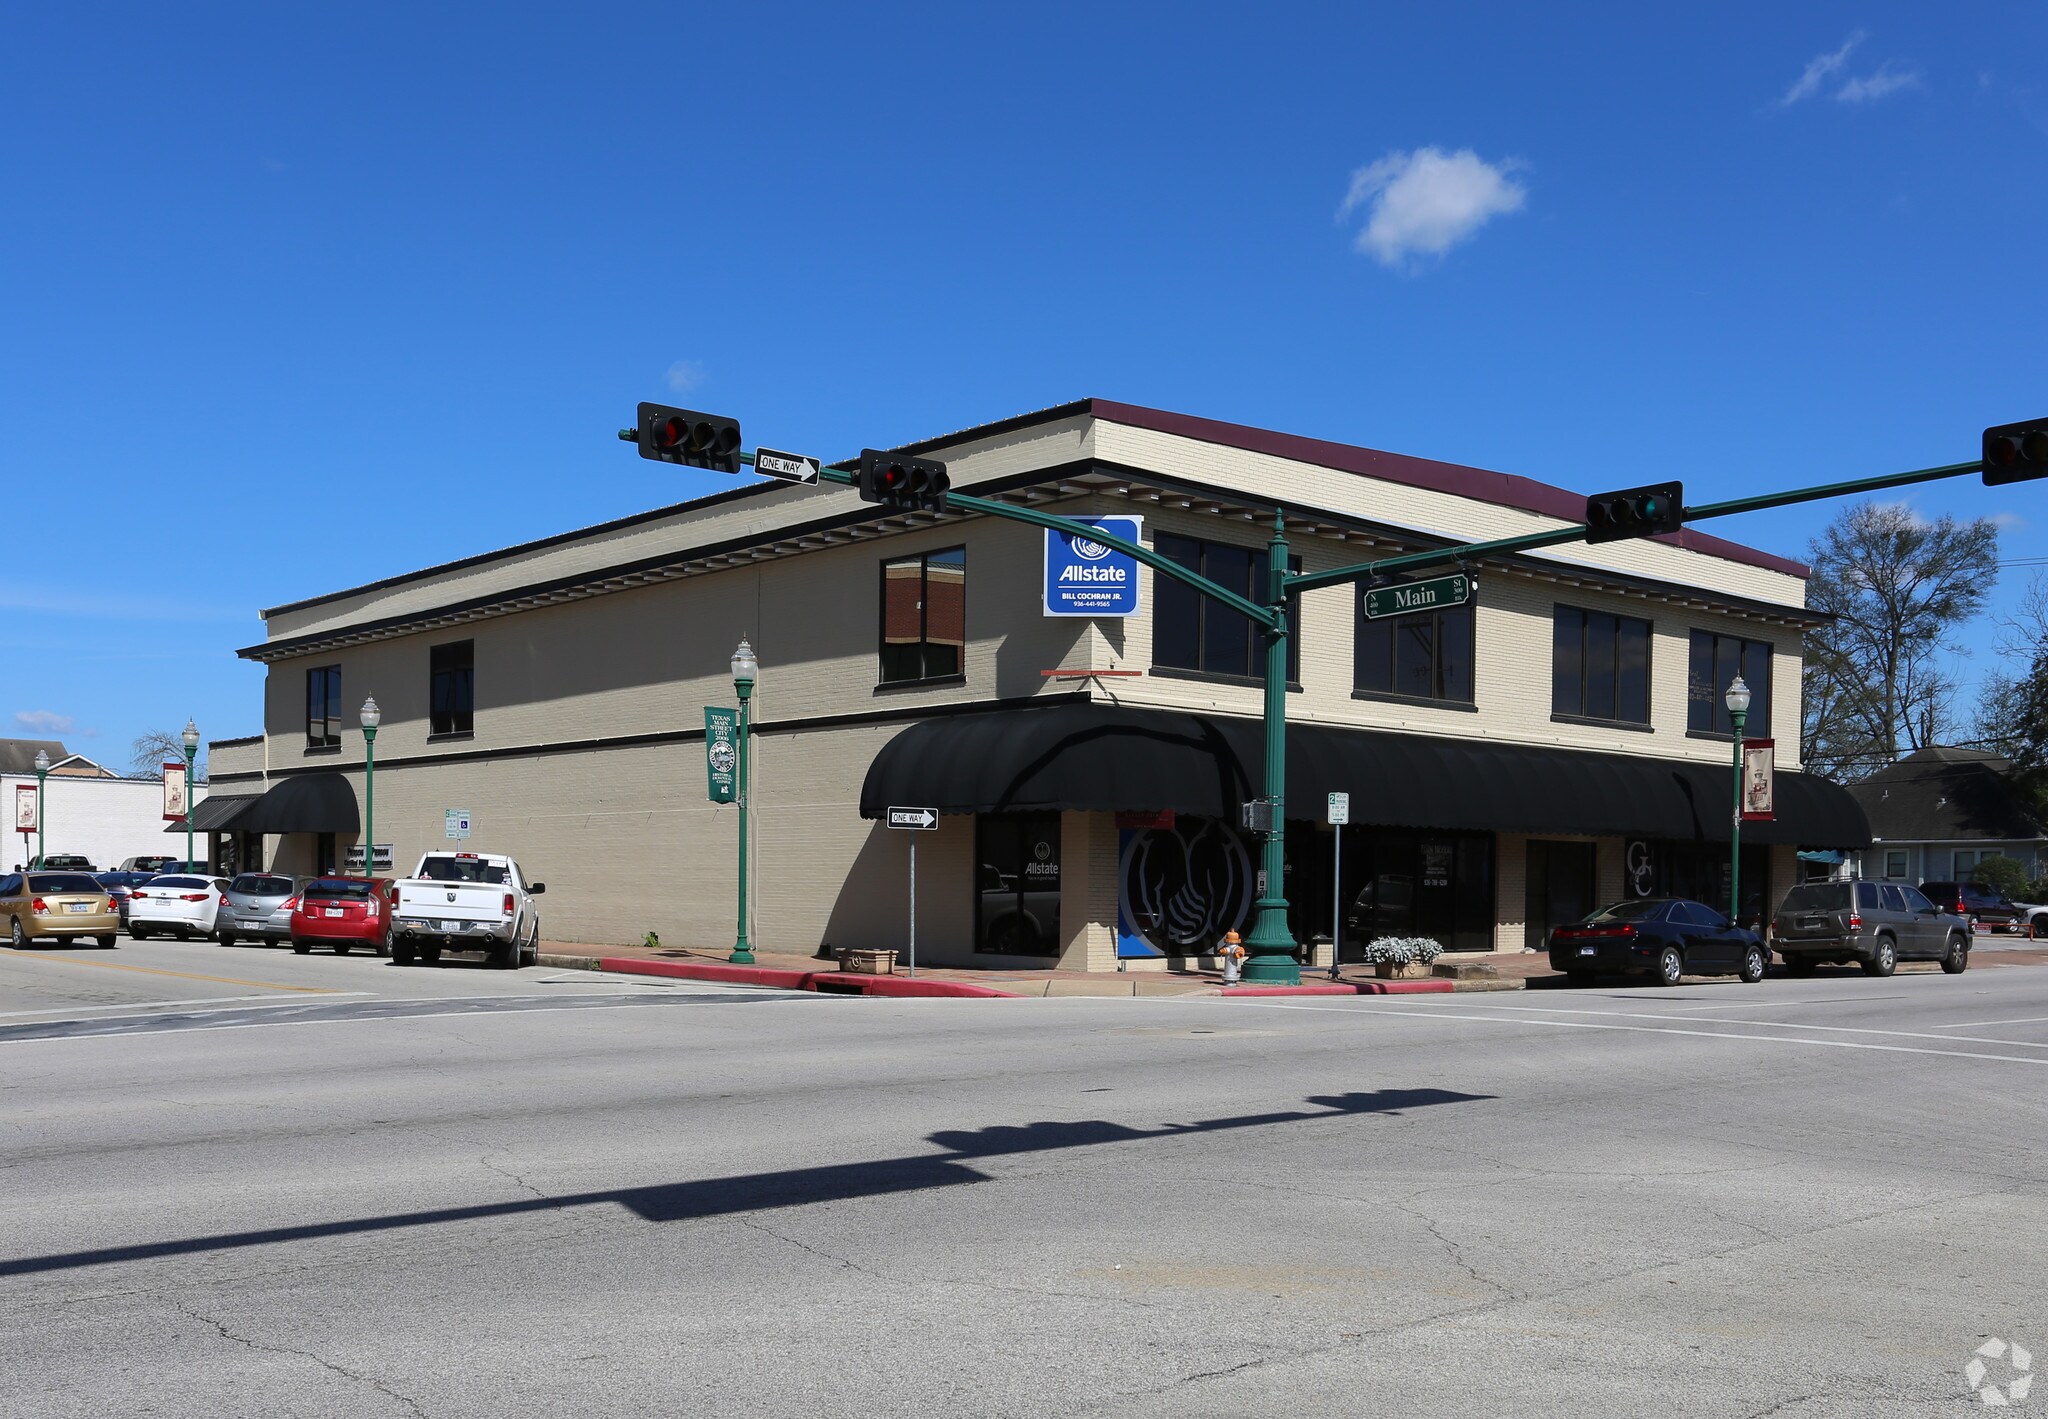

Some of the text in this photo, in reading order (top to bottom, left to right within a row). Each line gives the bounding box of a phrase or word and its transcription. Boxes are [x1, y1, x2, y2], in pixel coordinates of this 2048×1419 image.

[762, 457, 801, 473] ONE WAY
[1059, 565, 1126, 581] Allstate
[1453, 579, 1461, 588] St
[1370, 593, 1377, 601] N
[1395, 587, 1436, 608] Main
[1330, 795, 1335, 804] 2
[893, 814, 907, 822] ONE
[1025, 862, 1059, 874] Allstate
